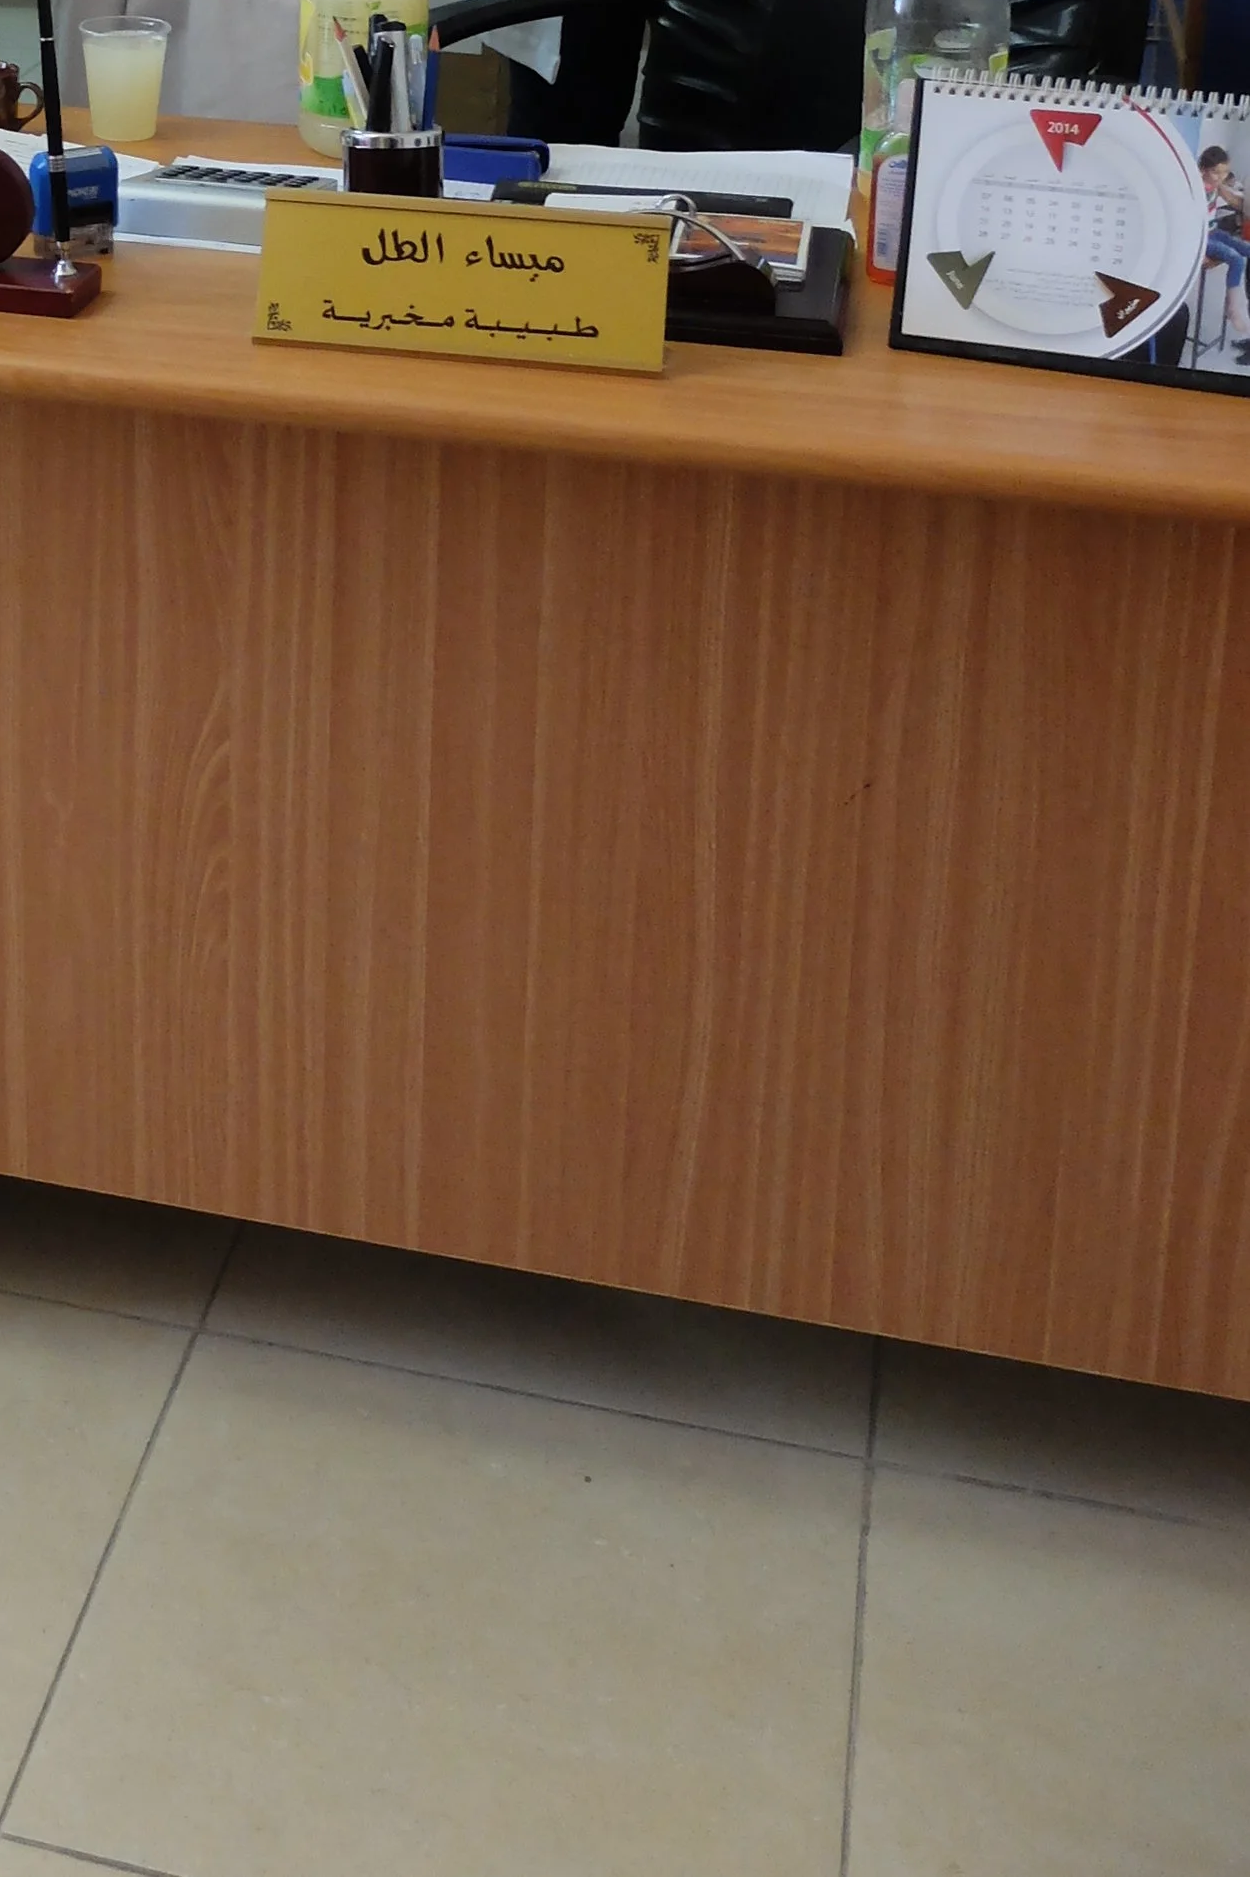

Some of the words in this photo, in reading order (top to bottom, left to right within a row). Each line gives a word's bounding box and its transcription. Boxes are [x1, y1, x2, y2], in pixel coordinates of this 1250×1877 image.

[1046, 121, 1081, 136] 2014
[362, 228, 445, 265] الطل
[466, 235, 565, 282] ميساء
[322, 299, 455, 331] مخبرية
[465, 308, 599, 342] طبيبة
